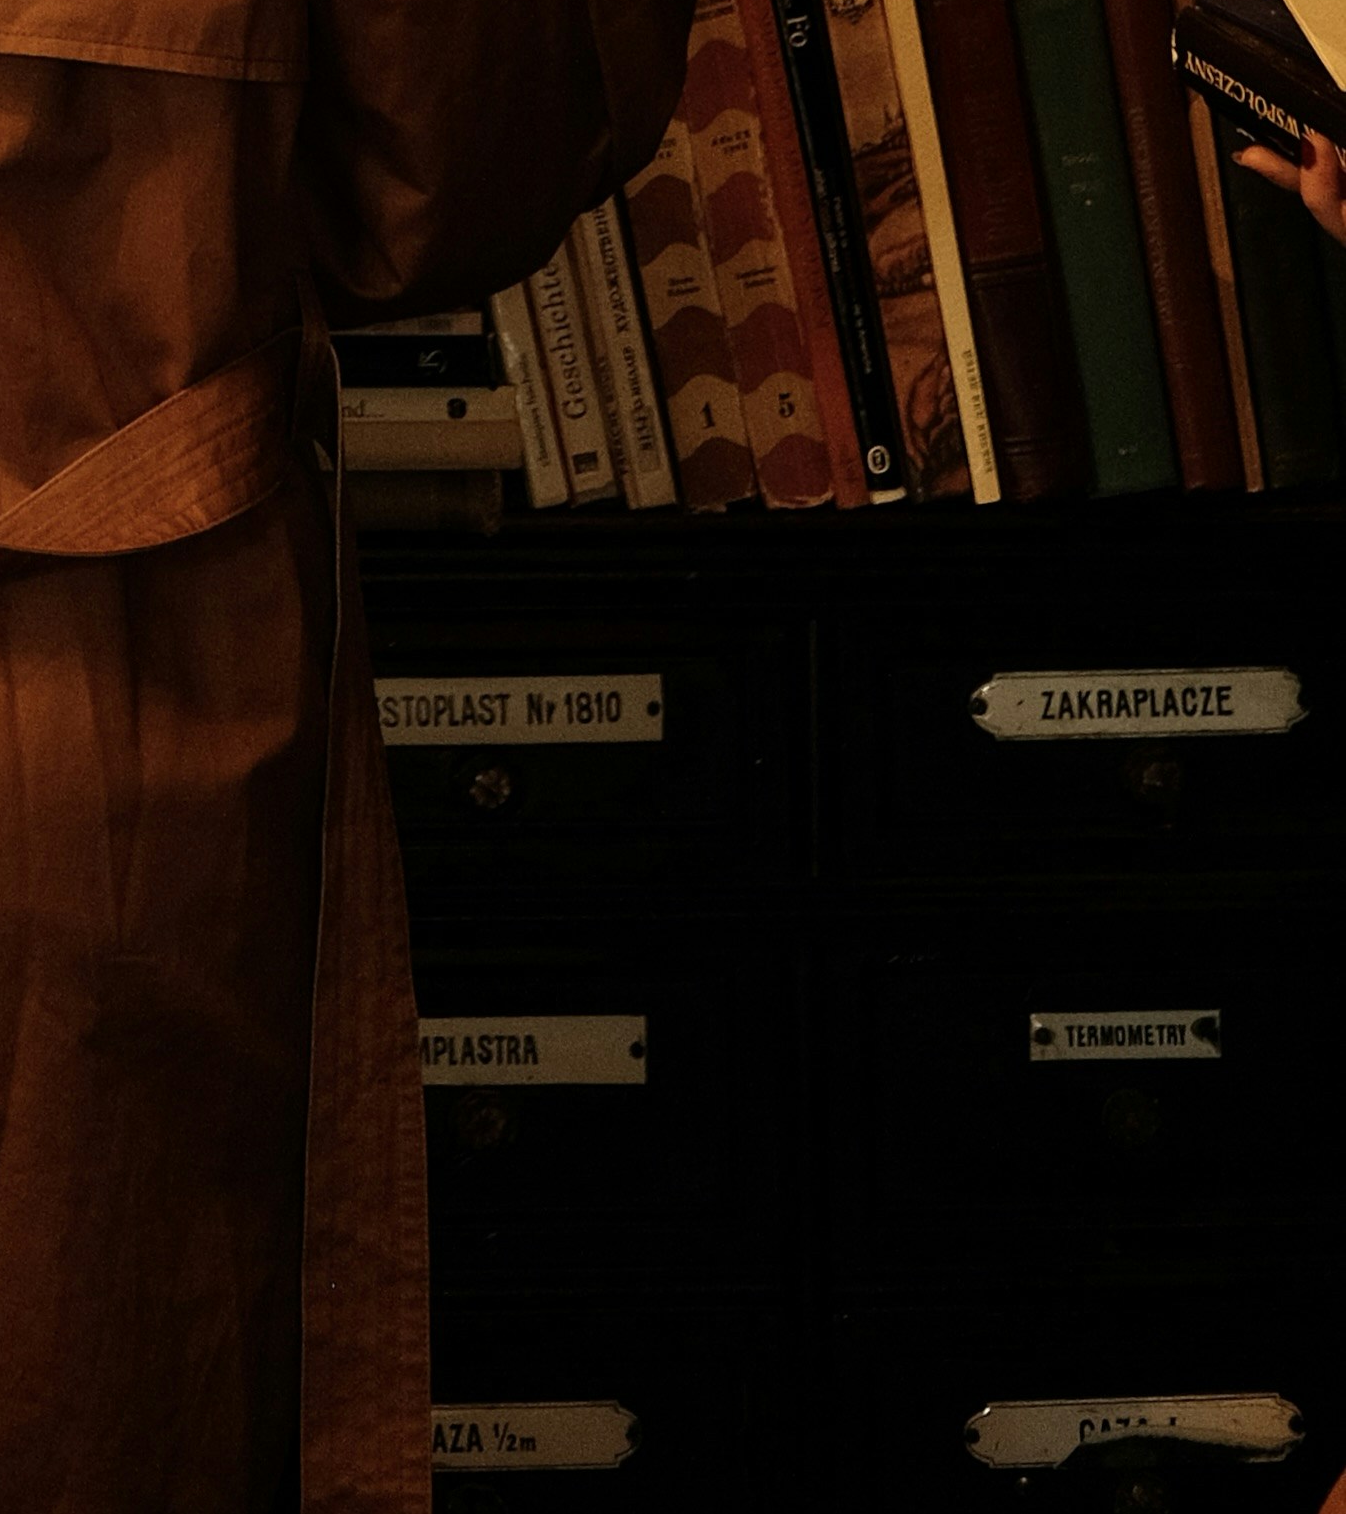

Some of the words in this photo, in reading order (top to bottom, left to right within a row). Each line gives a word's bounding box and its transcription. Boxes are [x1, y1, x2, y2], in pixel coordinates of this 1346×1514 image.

[536, 261, 588, 421] Geschichte
[699, 401, 717, 429] 1
[777, 392, 796, 420] 5
[526, 693, 556, 726] Nr
[564, 691, 622, 725] 1810
[1040, 685, 1236, 721] ZAKRAPLACZE
[1064, 1024, 1187, 1049] TERMOMETRY
